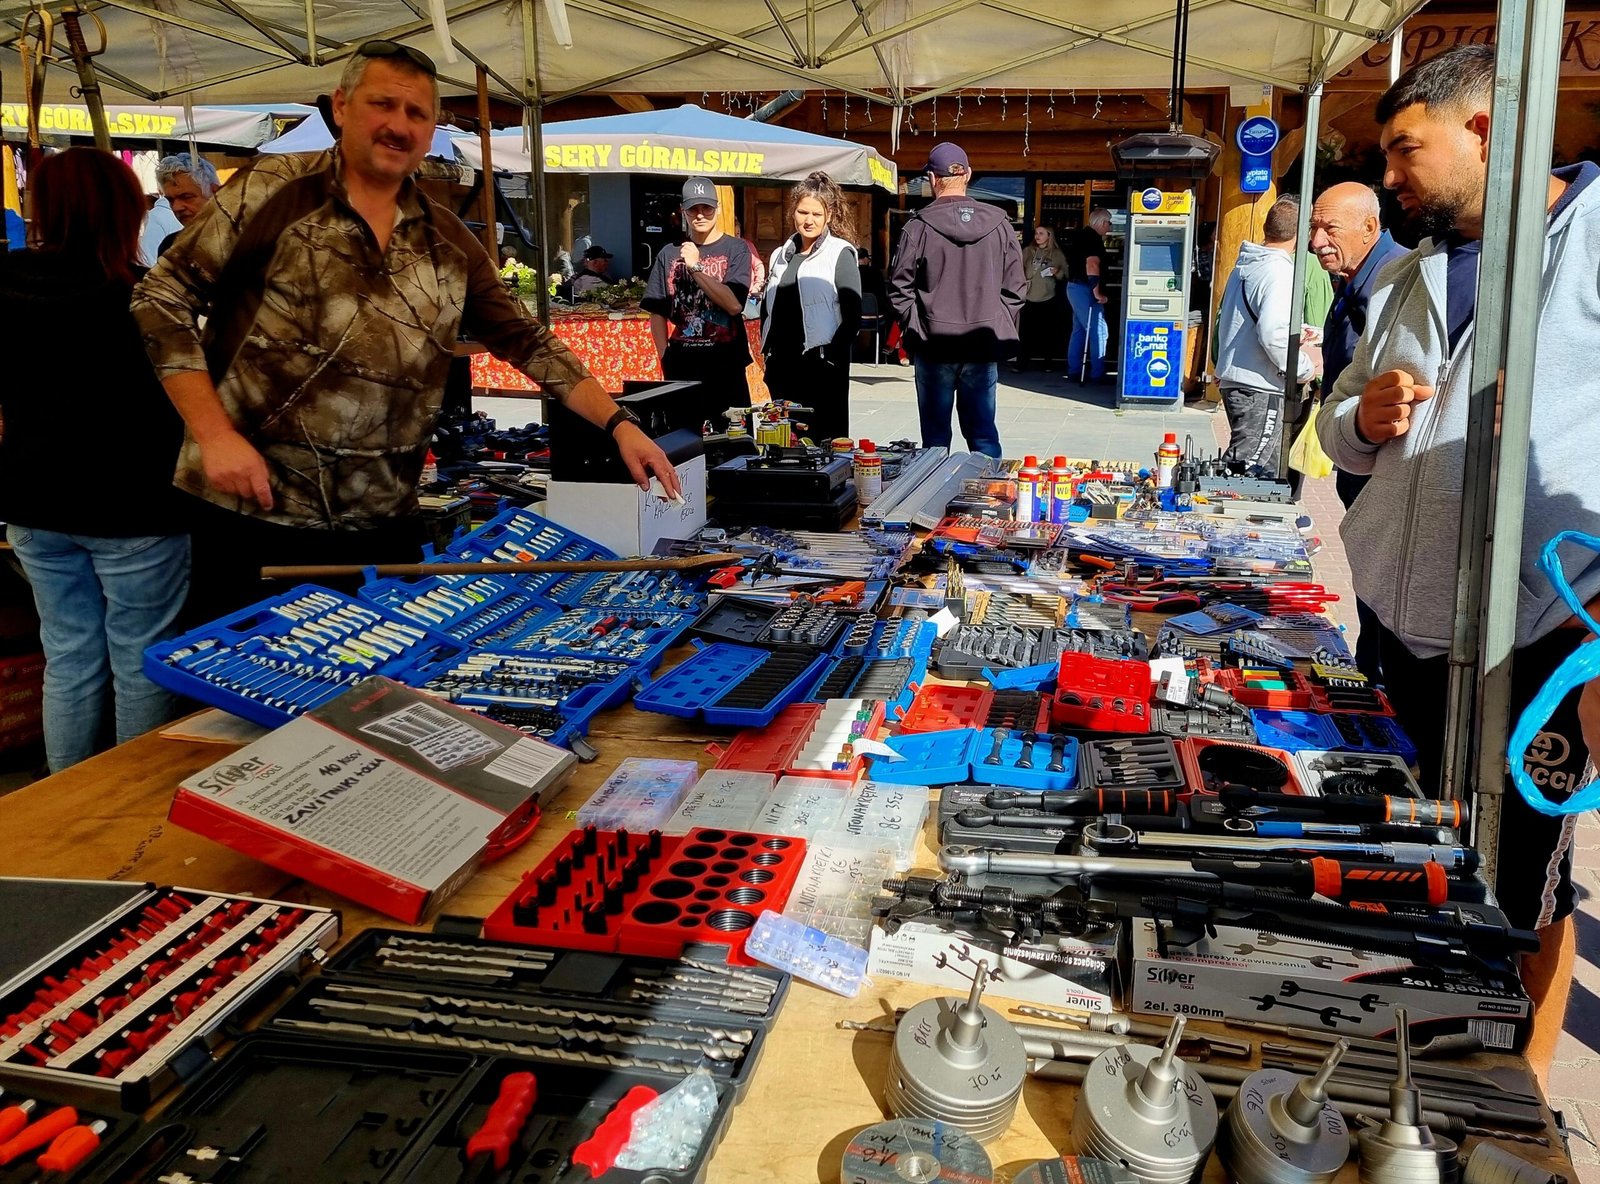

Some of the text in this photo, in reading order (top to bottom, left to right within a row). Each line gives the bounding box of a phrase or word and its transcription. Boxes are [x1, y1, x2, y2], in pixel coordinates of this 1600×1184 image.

[545, 140, 765, 175] SERY GÓRALSKIE
[1138, 333, 1168, 343] banko
[1149, 342, 1167, 350] mat
[1263, 409, 1278, 436] BLACK
[199, 756, 266, 795] Silver
[256, 765, 284, 781] TOOLS
[878, 816, 902, 830] 8€
[1147, 967, 1196, 985] Silver
[1400, 976, 1438, 988] 2el.
[1066, 996, 1102, 1012] Silver
[1144, 1000, 1224, 1018] 2el. 380mm
